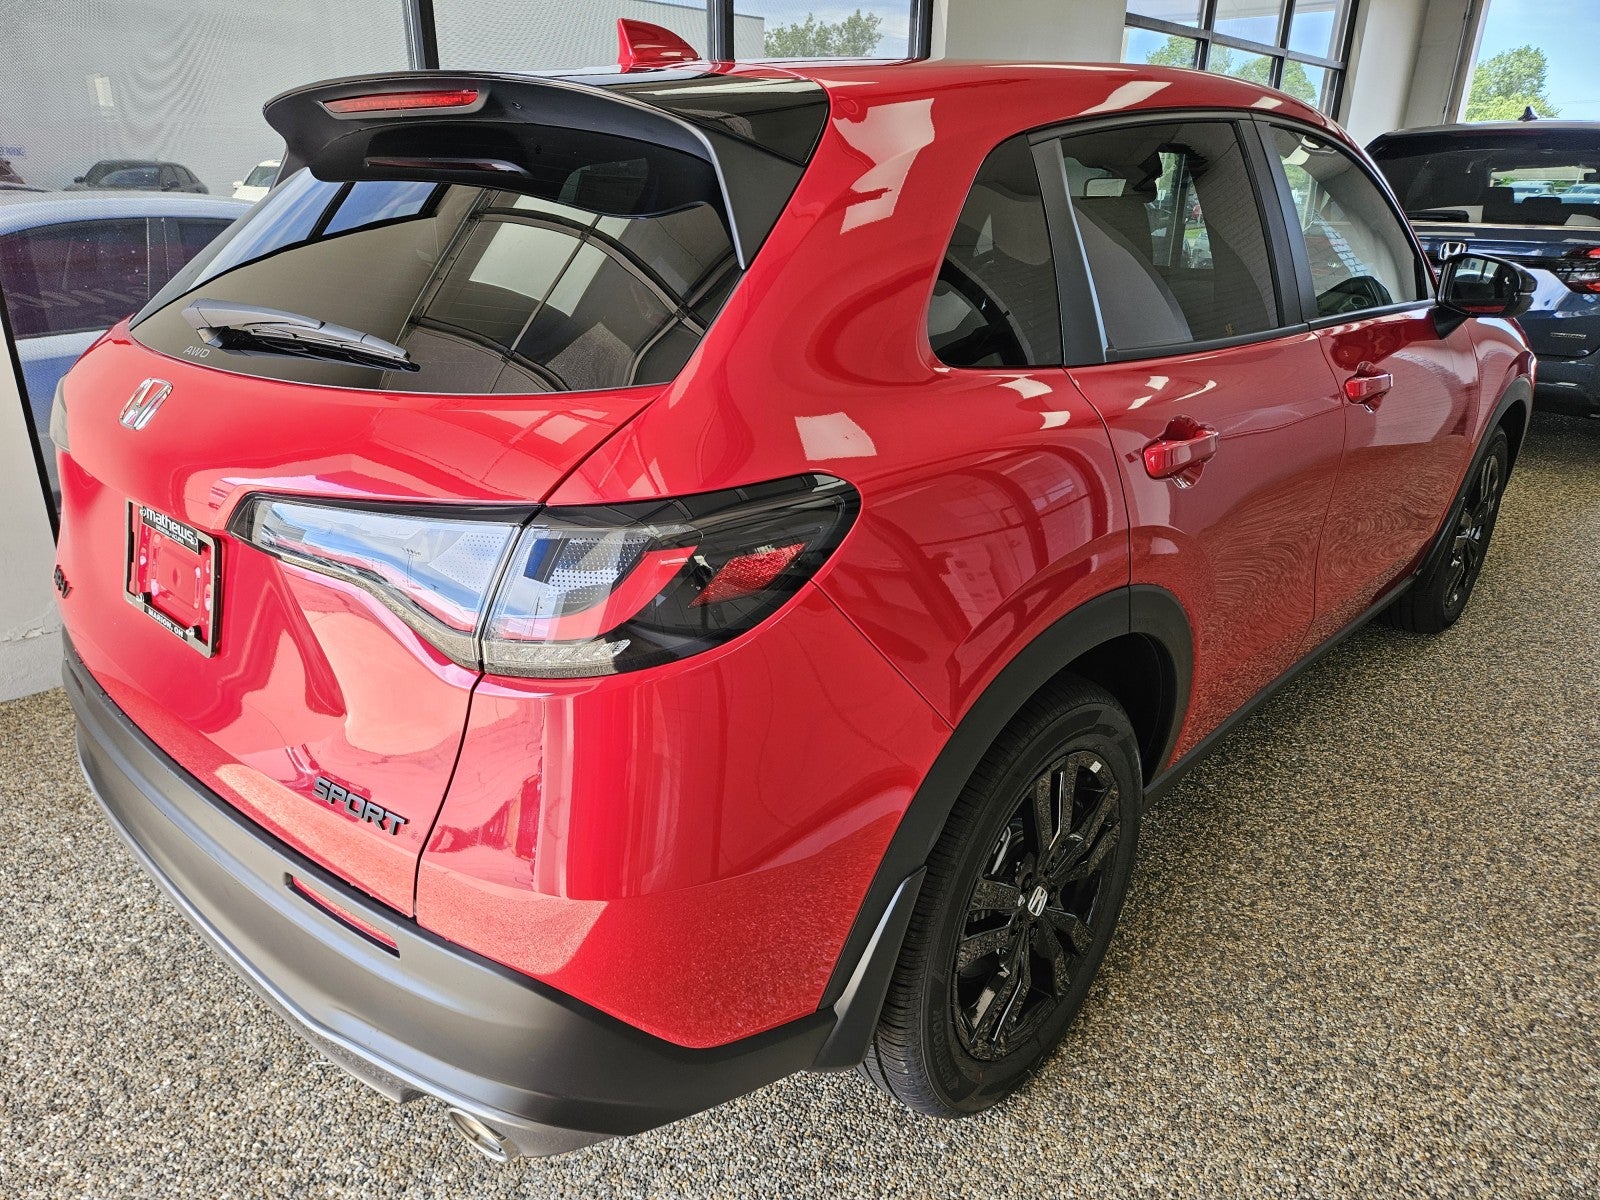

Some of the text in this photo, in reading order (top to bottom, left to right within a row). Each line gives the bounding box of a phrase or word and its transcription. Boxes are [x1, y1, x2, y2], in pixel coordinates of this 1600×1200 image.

[183, 345, 210, 358] AWD
[146, 506, 195, 542] mathews
[174, 627, 184, 638] OH
[311, 775, 410, 836] SPORT
